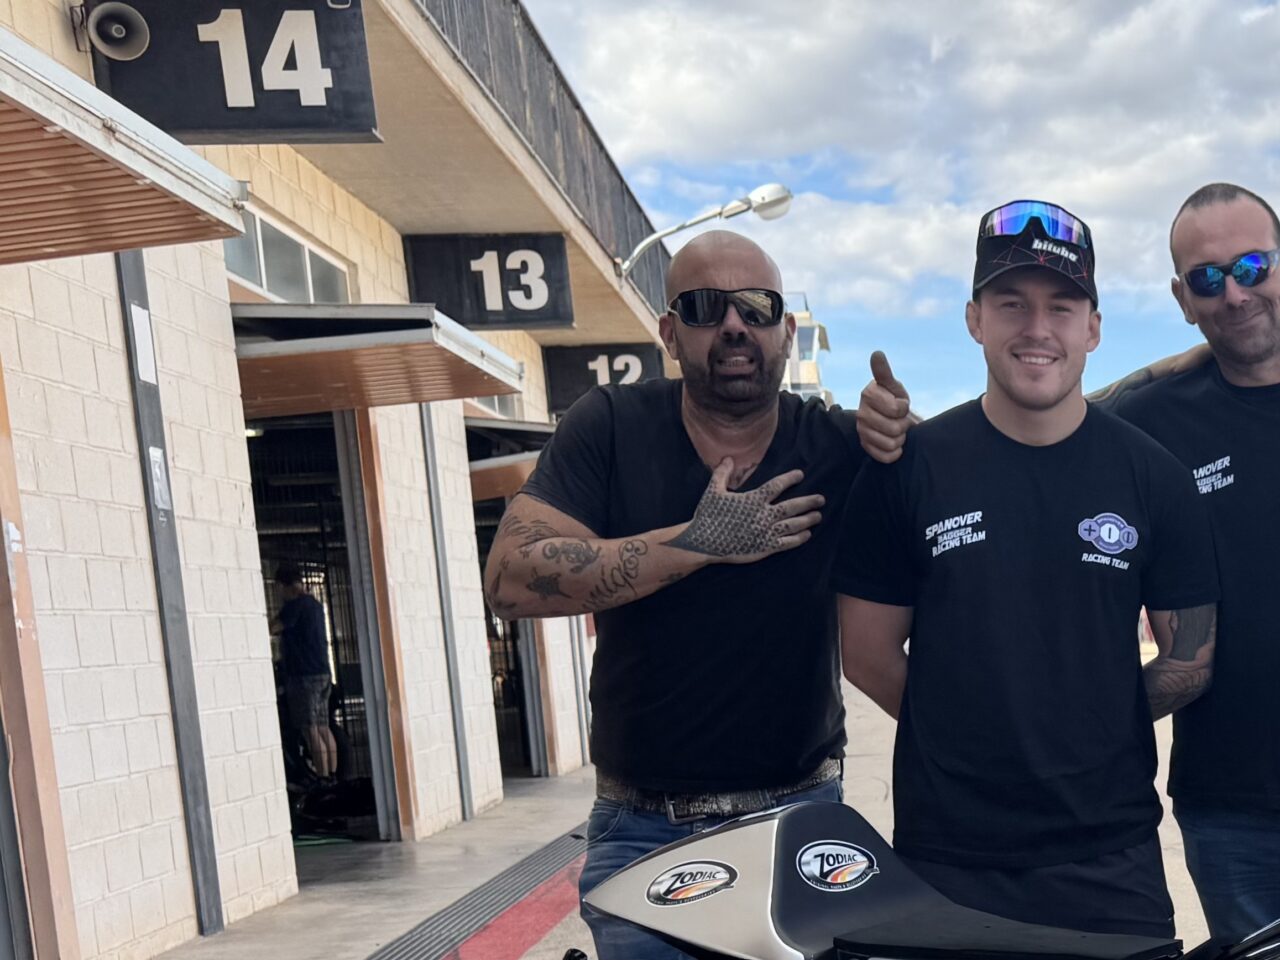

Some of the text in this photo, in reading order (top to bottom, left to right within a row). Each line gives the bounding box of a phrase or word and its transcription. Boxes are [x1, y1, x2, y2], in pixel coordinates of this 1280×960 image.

[197, 8, 333, 107] 14
[1032, 238, 1078, 262] bitubo
[471, 250, 549, 311] 13
[587, 354, 643, 386] 12
[1213, 473, 1235, 491] TEAM
[925, 510, 983, 541] SPANOVER
[937, 526, 973, 544] BAGGER
[932, 530, 986, 558] RACING TEAM
[1081, 552, 1130, 571] RACING TEAM
